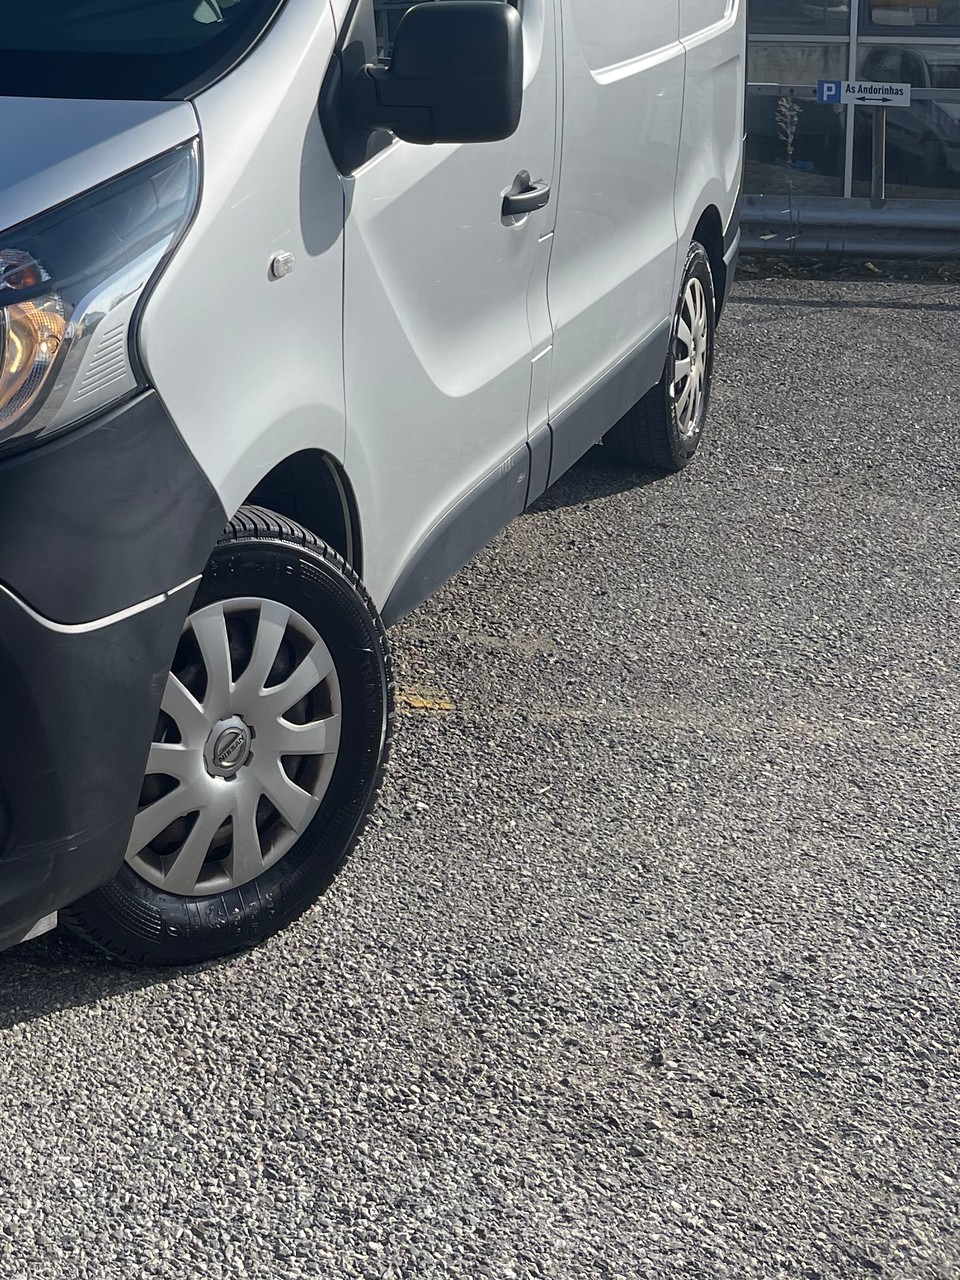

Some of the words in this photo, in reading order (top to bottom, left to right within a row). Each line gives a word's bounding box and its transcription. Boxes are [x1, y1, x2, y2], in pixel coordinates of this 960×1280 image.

[823, 83, 836, 101] P
[845, 84, 855, 94] As
[857, 84, 904, 96] Andorinhas
[218, 735, 245, 763] NISSAN
